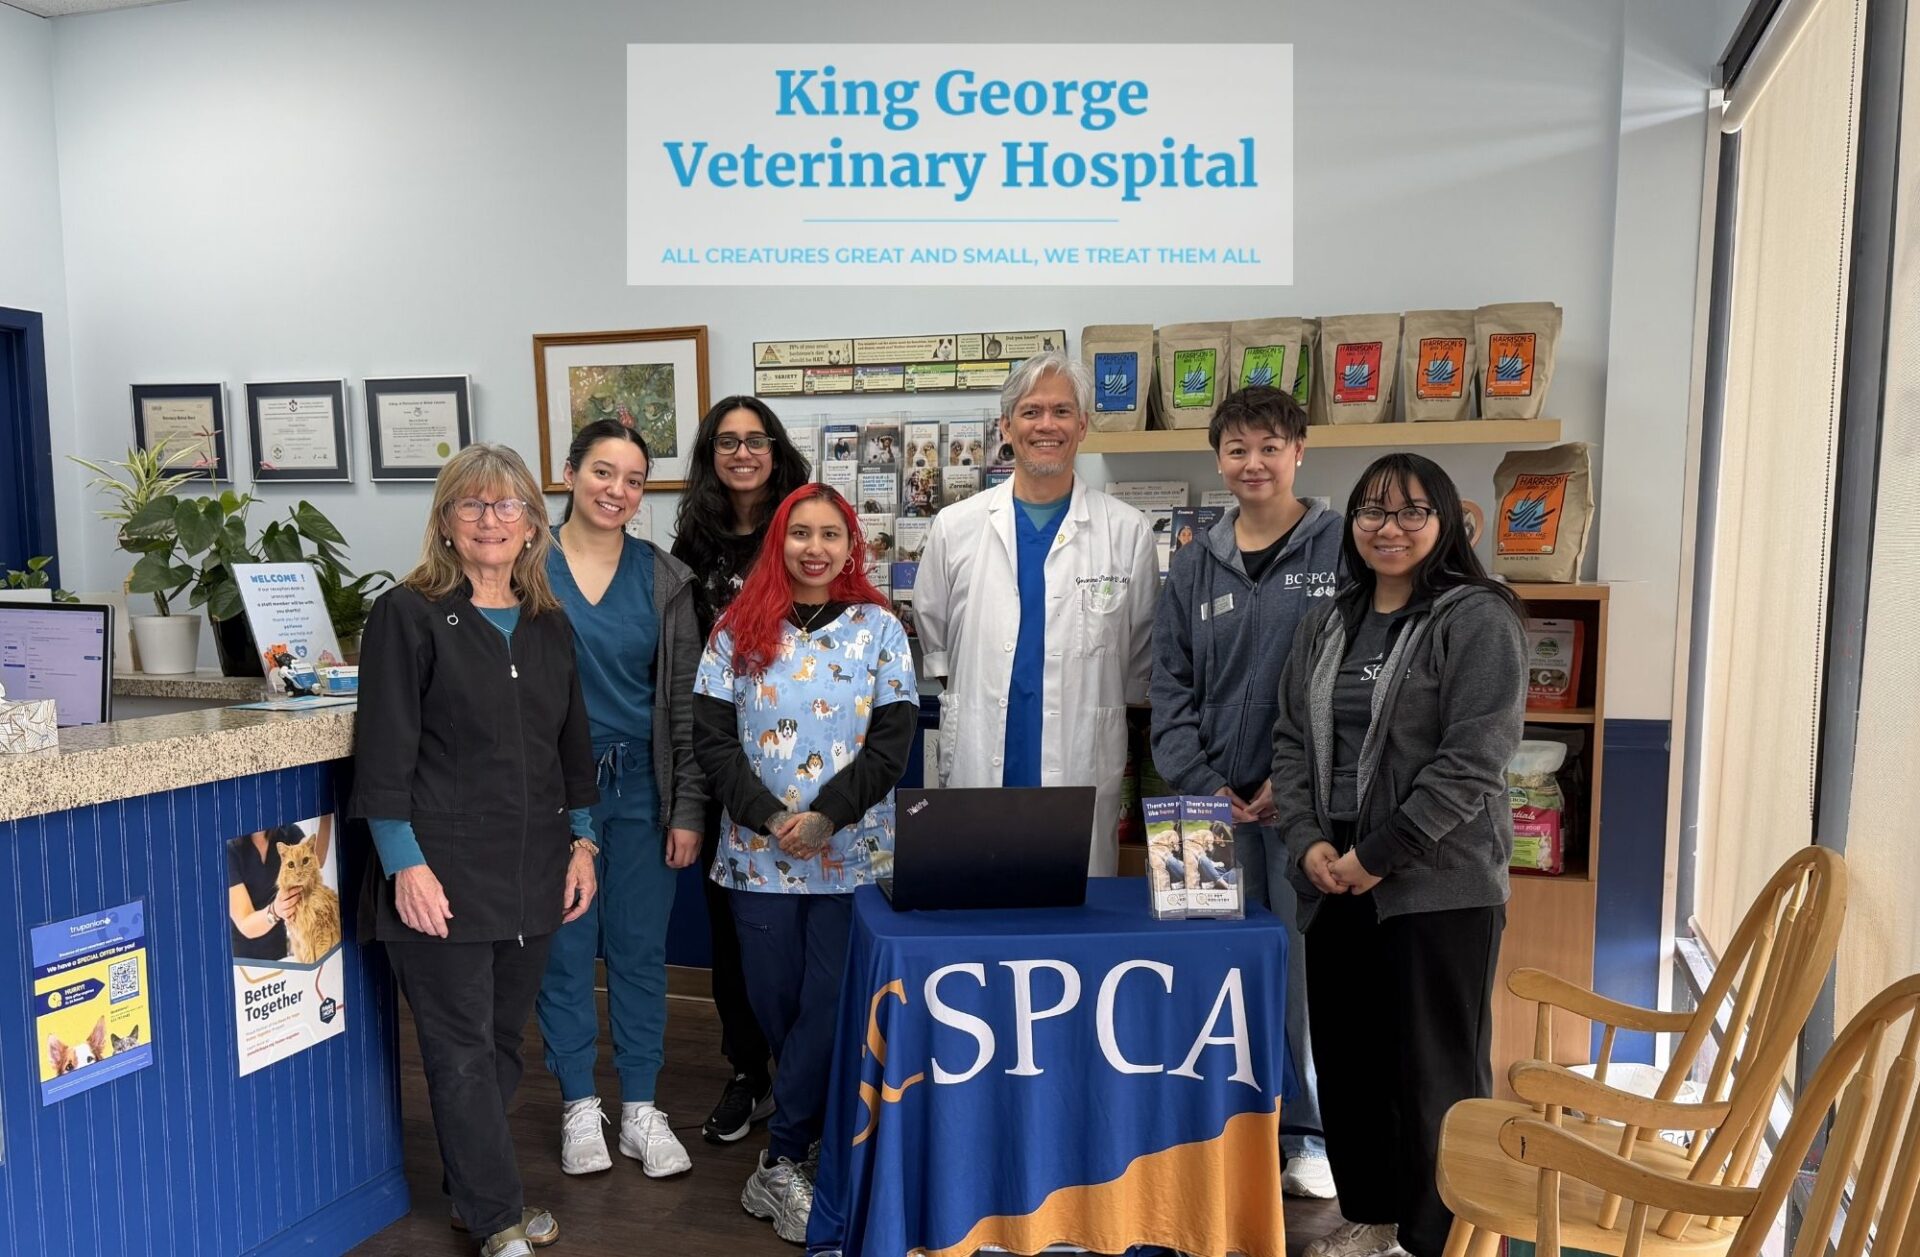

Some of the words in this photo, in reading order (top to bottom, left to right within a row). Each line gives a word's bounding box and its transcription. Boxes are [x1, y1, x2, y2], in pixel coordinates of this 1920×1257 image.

[250, 574, 297, 583] WELCOME
[1538, 670, 1552, 685] C
[70, 918, 106, 934] trupanion
[57, 962, 71, 970] have
[77, 954, 99, 965] SPECIAL
[99, 948, 116, 958] OFFER
[244, 980, 286, 1006] Better
[245, 990, 304, 1021] Together
[923, 958, 1262, 1093] SPCA
